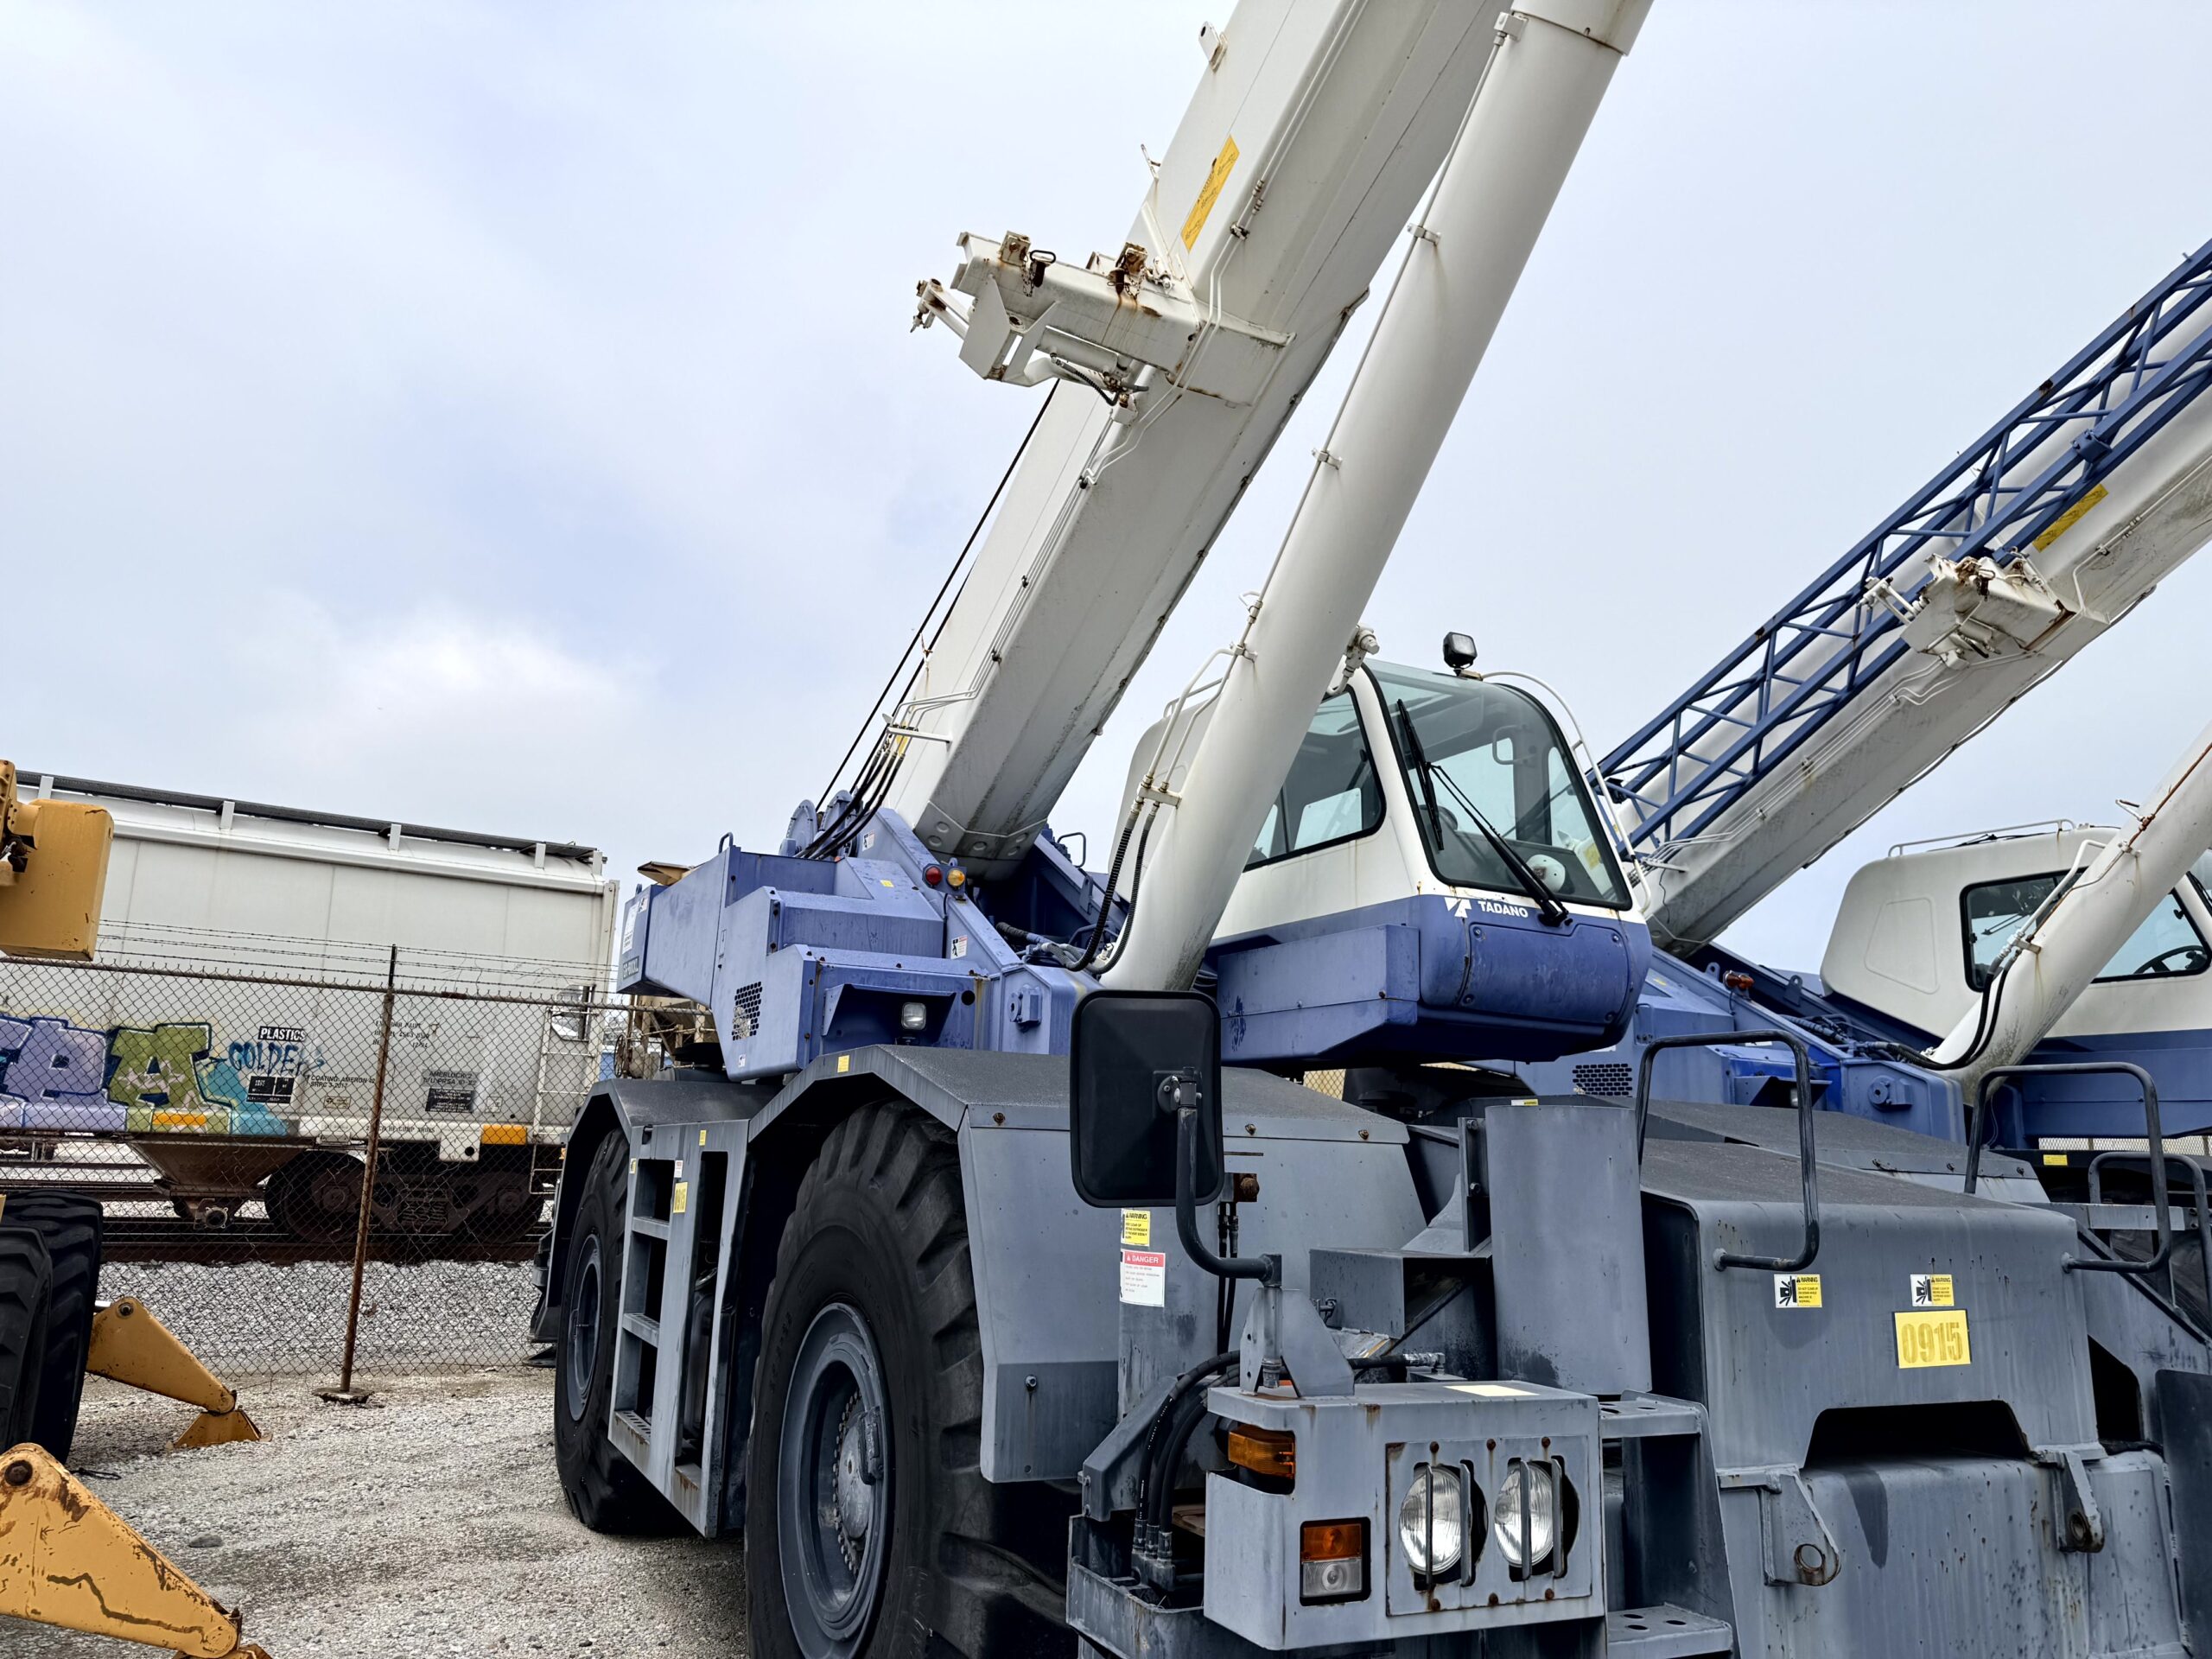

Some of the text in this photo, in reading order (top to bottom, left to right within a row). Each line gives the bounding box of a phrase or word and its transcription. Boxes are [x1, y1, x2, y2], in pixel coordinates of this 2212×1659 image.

[1478, 900, 1529, 918] TADANO
[260, 1027, 305, 1040] PLASTICS
[1132, 1255, 1160, 1264] DANGER
[1901, 1322, 1963, 1364] 0915
